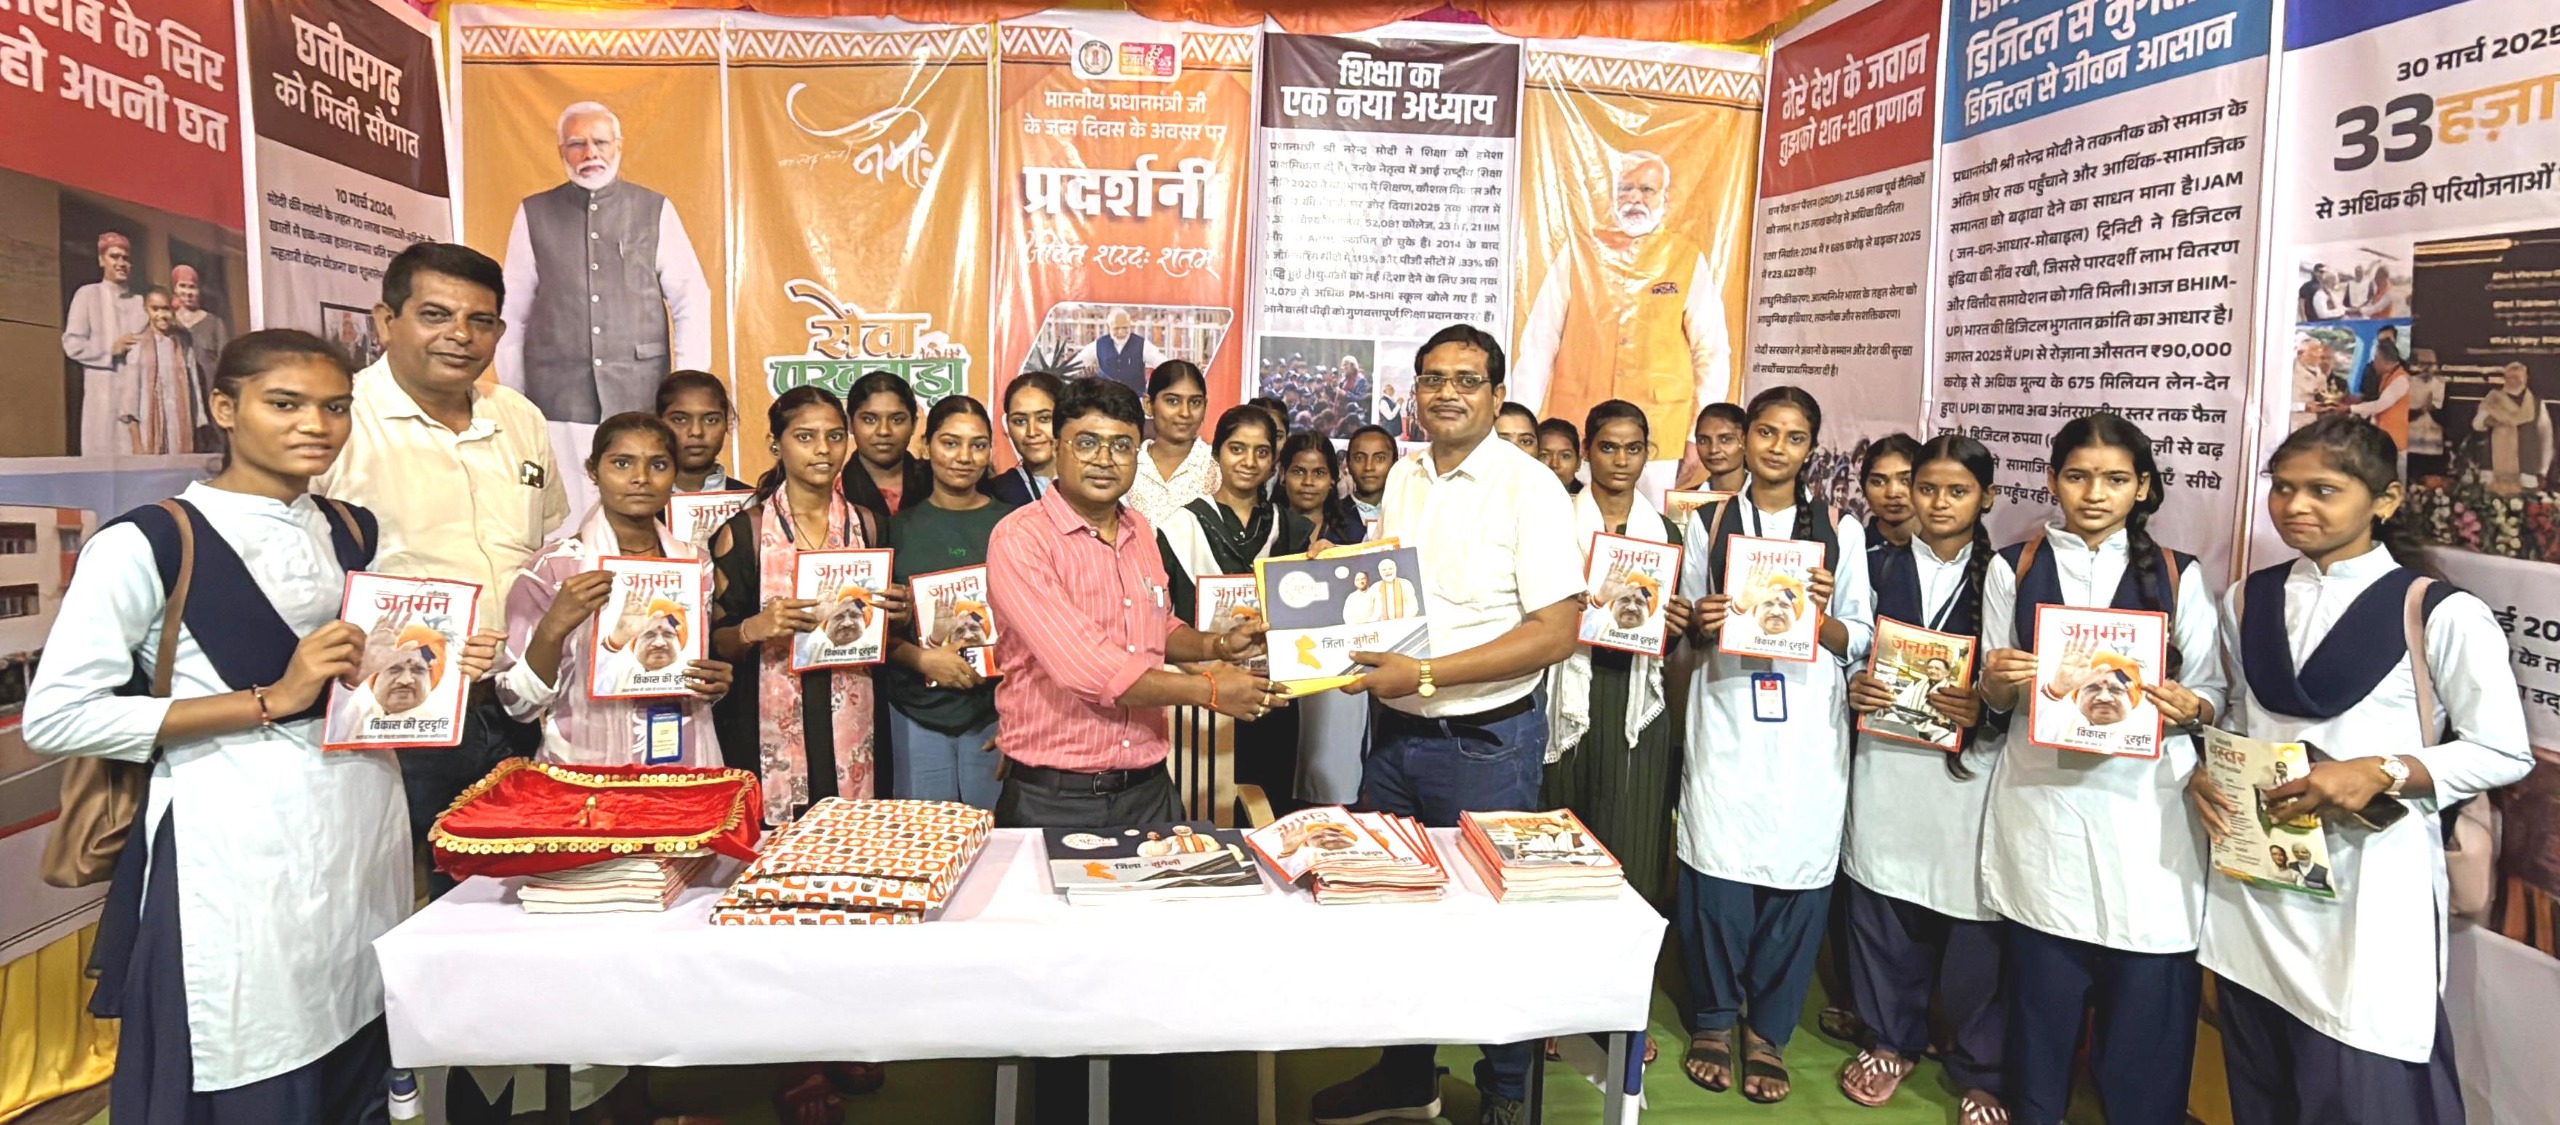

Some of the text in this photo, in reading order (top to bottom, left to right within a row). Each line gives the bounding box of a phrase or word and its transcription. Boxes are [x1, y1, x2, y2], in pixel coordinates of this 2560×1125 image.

[109, 0, 151, 58] के
[156, 19, 225, 92] सिर
[290, 14, 402, 116] छत्तीसगढ़
[1964, 77, 2035, 126] डिजिटल
[2037, 63, 2061, 102] से
[2062, 49, 2130, 93] जीवन
[2135, 11, 2237, 73] आसान
[1965, 10, 2063, 81] डिजिटल
[2396, 57, 2429, 81] 30
[2434, 36, 2486, 71] मार्च
[1338, 52, 1444, 89] शिक्षा का
[1782, 33, 1930, 120] मेरे देश के जवान
[59, 55, 169, 133] अपनी
[172, 97, 229, 152] छत
[272, 70, 420, 159] को मिली सौगात
[1045, 87, 1207, 114] माननीय प्रधानमंत्री जी
[1281, 86, 1498, 125] एक नया अध्याय
[1023, 113, 1227, 142] के जन्म दिवस के अवसर पर
[1779, 86, 1926, 167] तुझको शत-शत प्रणाम
[1953, 99, 2248, 183] प्रधानमंत्री श्री नरेन्द्र मोदी ने तकनीक को समाज के
[1376, 144, 1397, 156] मोदी
[1405, 145, 1413, 156] ने
[1421, 146, 1447, 158] शिक्षा
[1455, 147, 1469, 159] को
[1952, 136, 2247, 209] अंतिम छोर तक पहुँचाने और आर्थिक-सामाजिक
[335, 188, 347, 204] 10
[349, 192, 368, 211] मार्च
[1022, 154, 1222, 219] प्रदर्शनी
[1950, 217, 1988, 234] समानता
[1991, 210, 2005, 226] को
[2009, 206, 2043, 225] बढ़ावा
[2047, 199, 2066, 217] देने
[2069, 197, 2089, 211] का
[2093, 189, 2135, 208] साधन
[2139, 182, 2176, 200] माना
[2315, 162, 2555, 219] से अधिक की परियोजनाओं
[1900, 230, 1921, 243] 2025
[1957, 205, 2242, 259] जन-धन-आधार-मोबाइल) ट्रिनिटी ने डिजिटल
[1948, 270, 1977, 288] इंडिया
[1980, 266, 1992, 281] की
[2015, 260, 2040, 277] रखी,
[2043, 254, 2081, 274] जिससे
[2083, 247, 2138, 269] पारदर्शी
[2140, 247, 2174, 263] लाभ
[2177, 240, 2240, 259] वितरण
[789, 285, 928, 360] सेवा
[1945, 341, 2232, 362] अगस्त 2025 में UPI से रोज़ाना औसतन ₹90,000
[1944, 371, 2230, 392] करोड़ से अधिक मूल्य के 675 मिलियन लेन-देन
[1322, 631, 1379, 649] जिला मुंगेली
[1754, 636, 1777, 648] विकास
[1778, 637, 1788, 647] की
[2519, 646, 2542, 667] के
[370, 717, 449, 733] विकास की दूरदृष्टि
[2076, 726, 2107, 740] विकास
[2125, 733, 2152, 747] दूरदृष्टि
